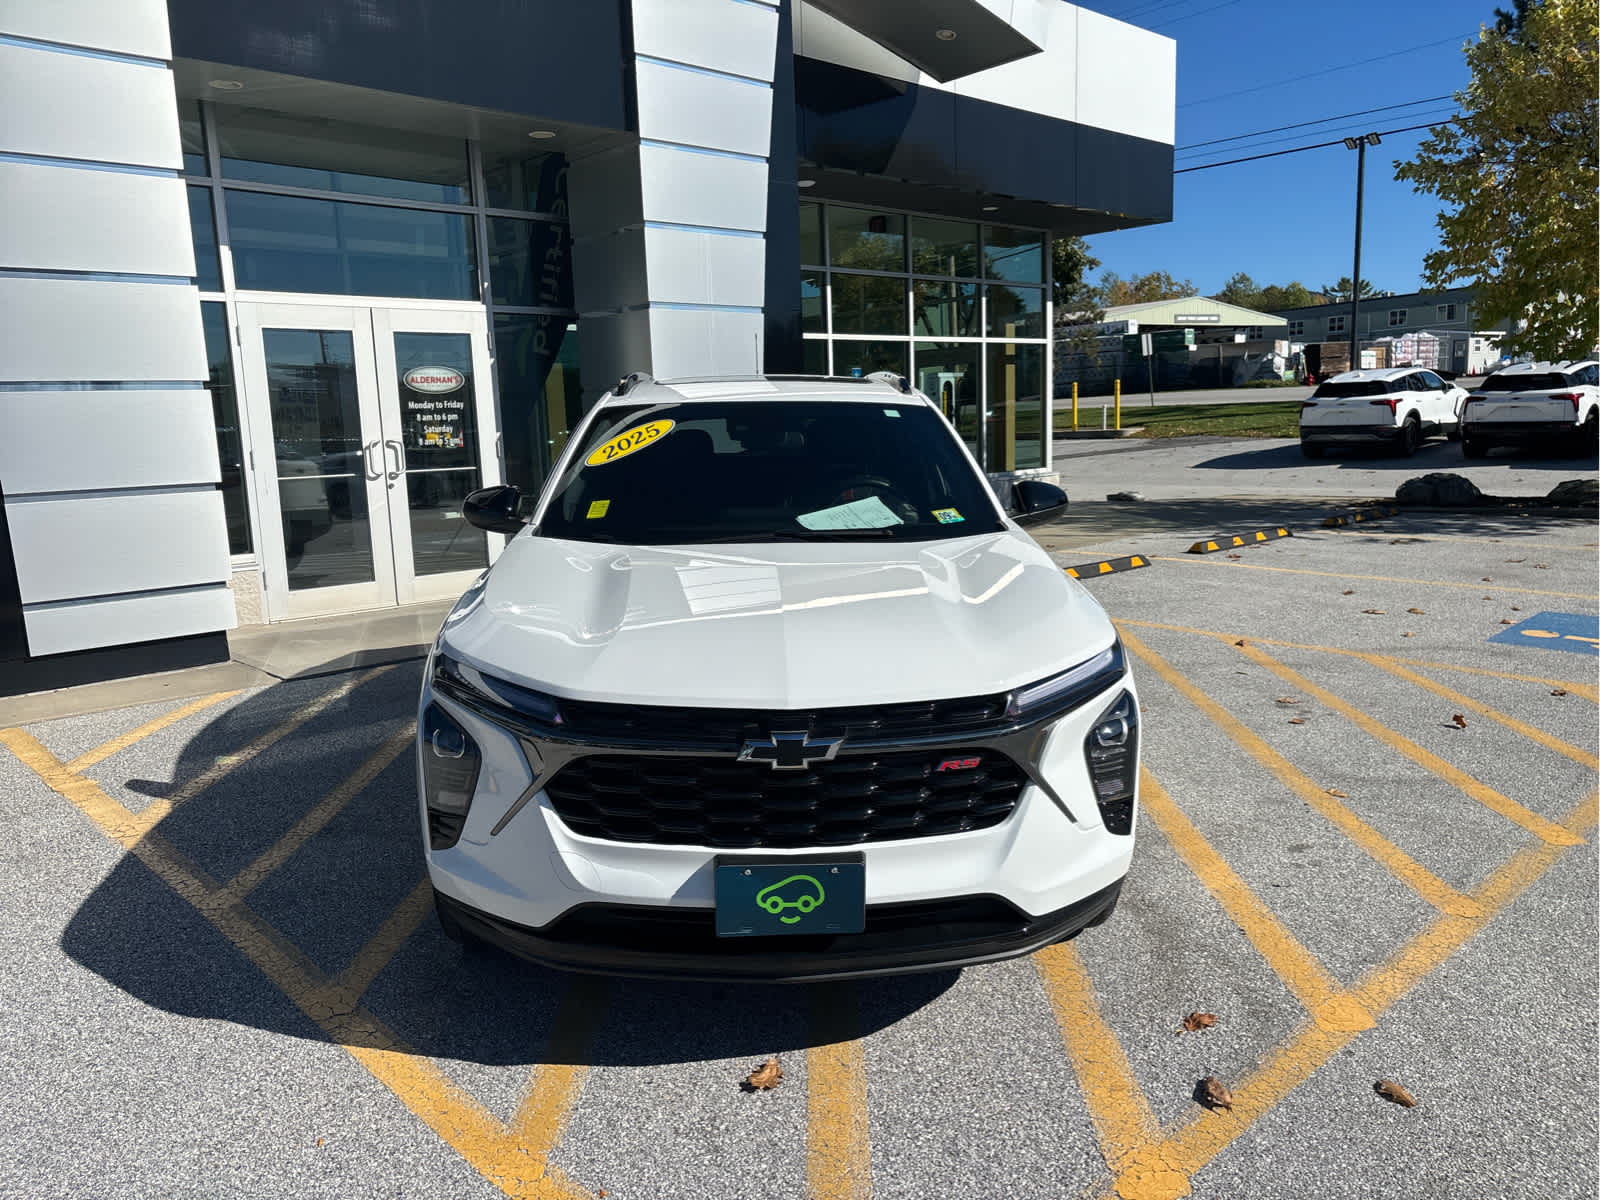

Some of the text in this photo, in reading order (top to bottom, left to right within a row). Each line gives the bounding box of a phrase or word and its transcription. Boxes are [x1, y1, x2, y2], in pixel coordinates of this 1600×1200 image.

[410, 376, 459, 384] ALDERMAN'S
[408, 401, 434, 410] Monday
[444, 401, 464, 410] Friday
[434, 413, 441, 421] to
[442, 413, 447, 421] 6
[448, 414, 458, 422] pm
[424, 424, 453, 433] Saturday
[444, 437, 449, 445] 5
[602, 424, 660, 460] 2025
[936, 757, 981, 771] RS
